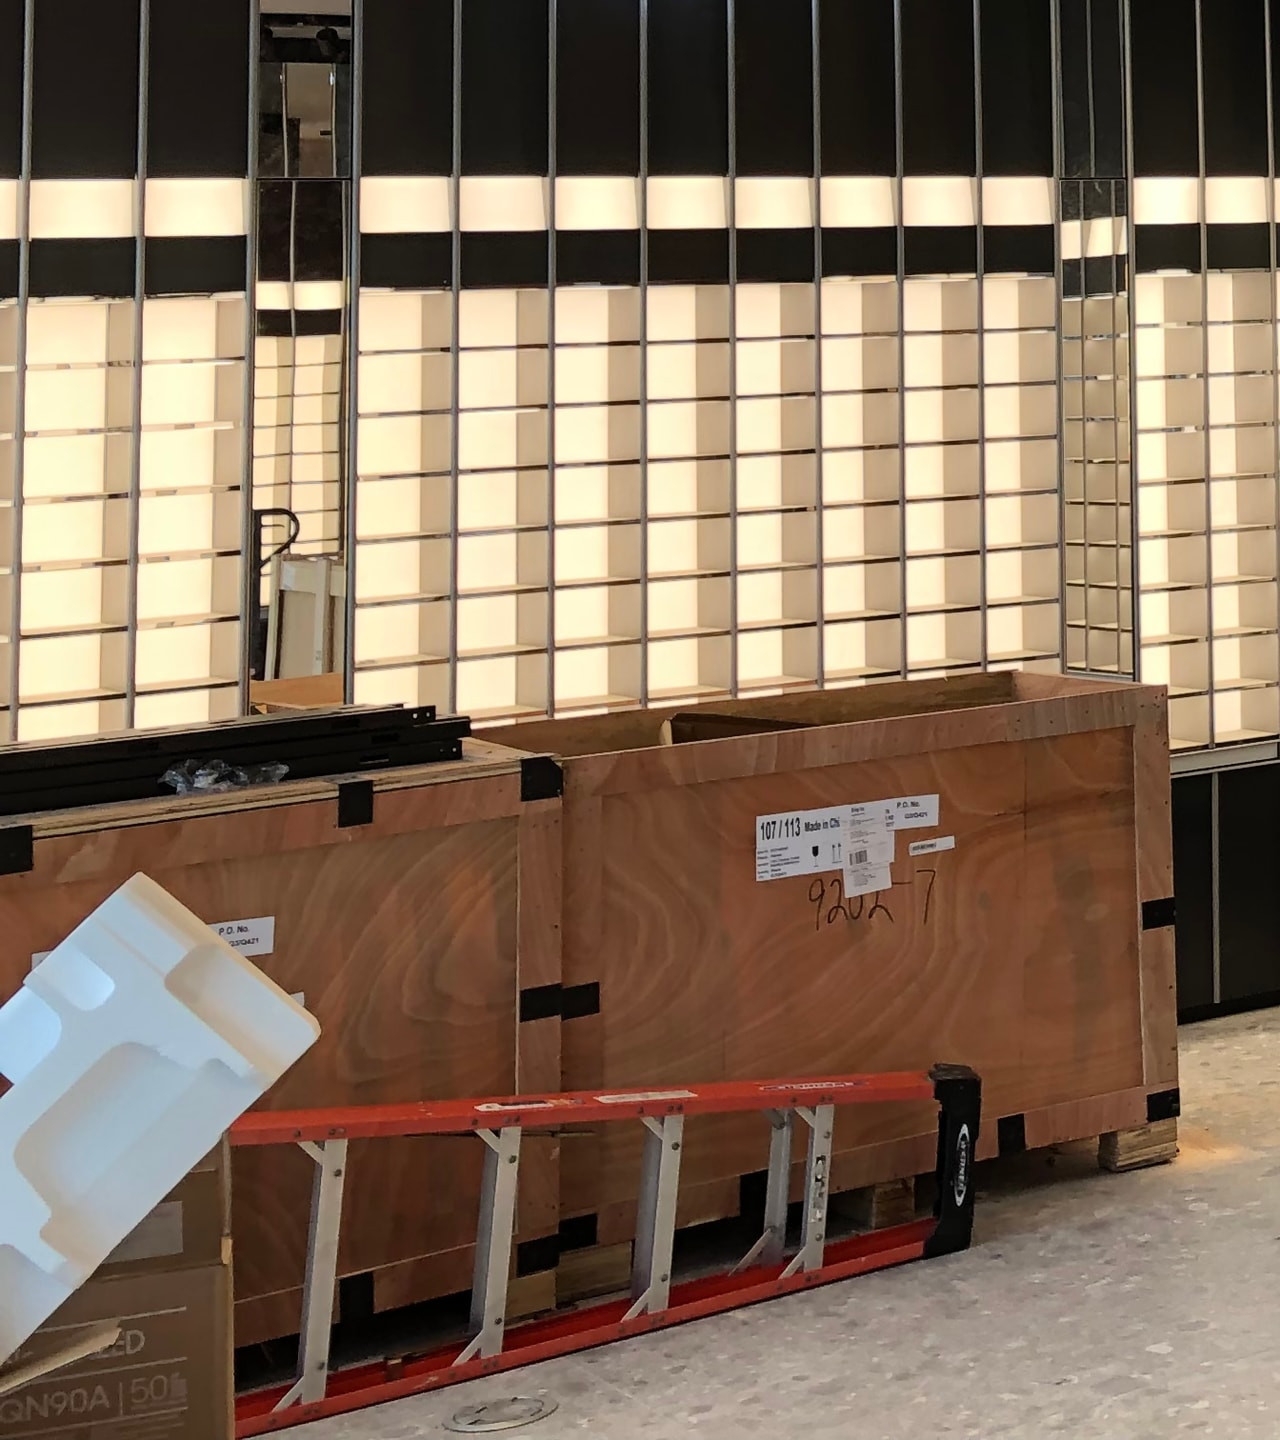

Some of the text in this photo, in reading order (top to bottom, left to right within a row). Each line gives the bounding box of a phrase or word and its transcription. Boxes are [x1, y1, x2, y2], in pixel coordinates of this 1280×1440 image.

[760, 821, 776, 841] 107
[785, 817, 801, 838] 113
[804, 821, 822, 832] Made
